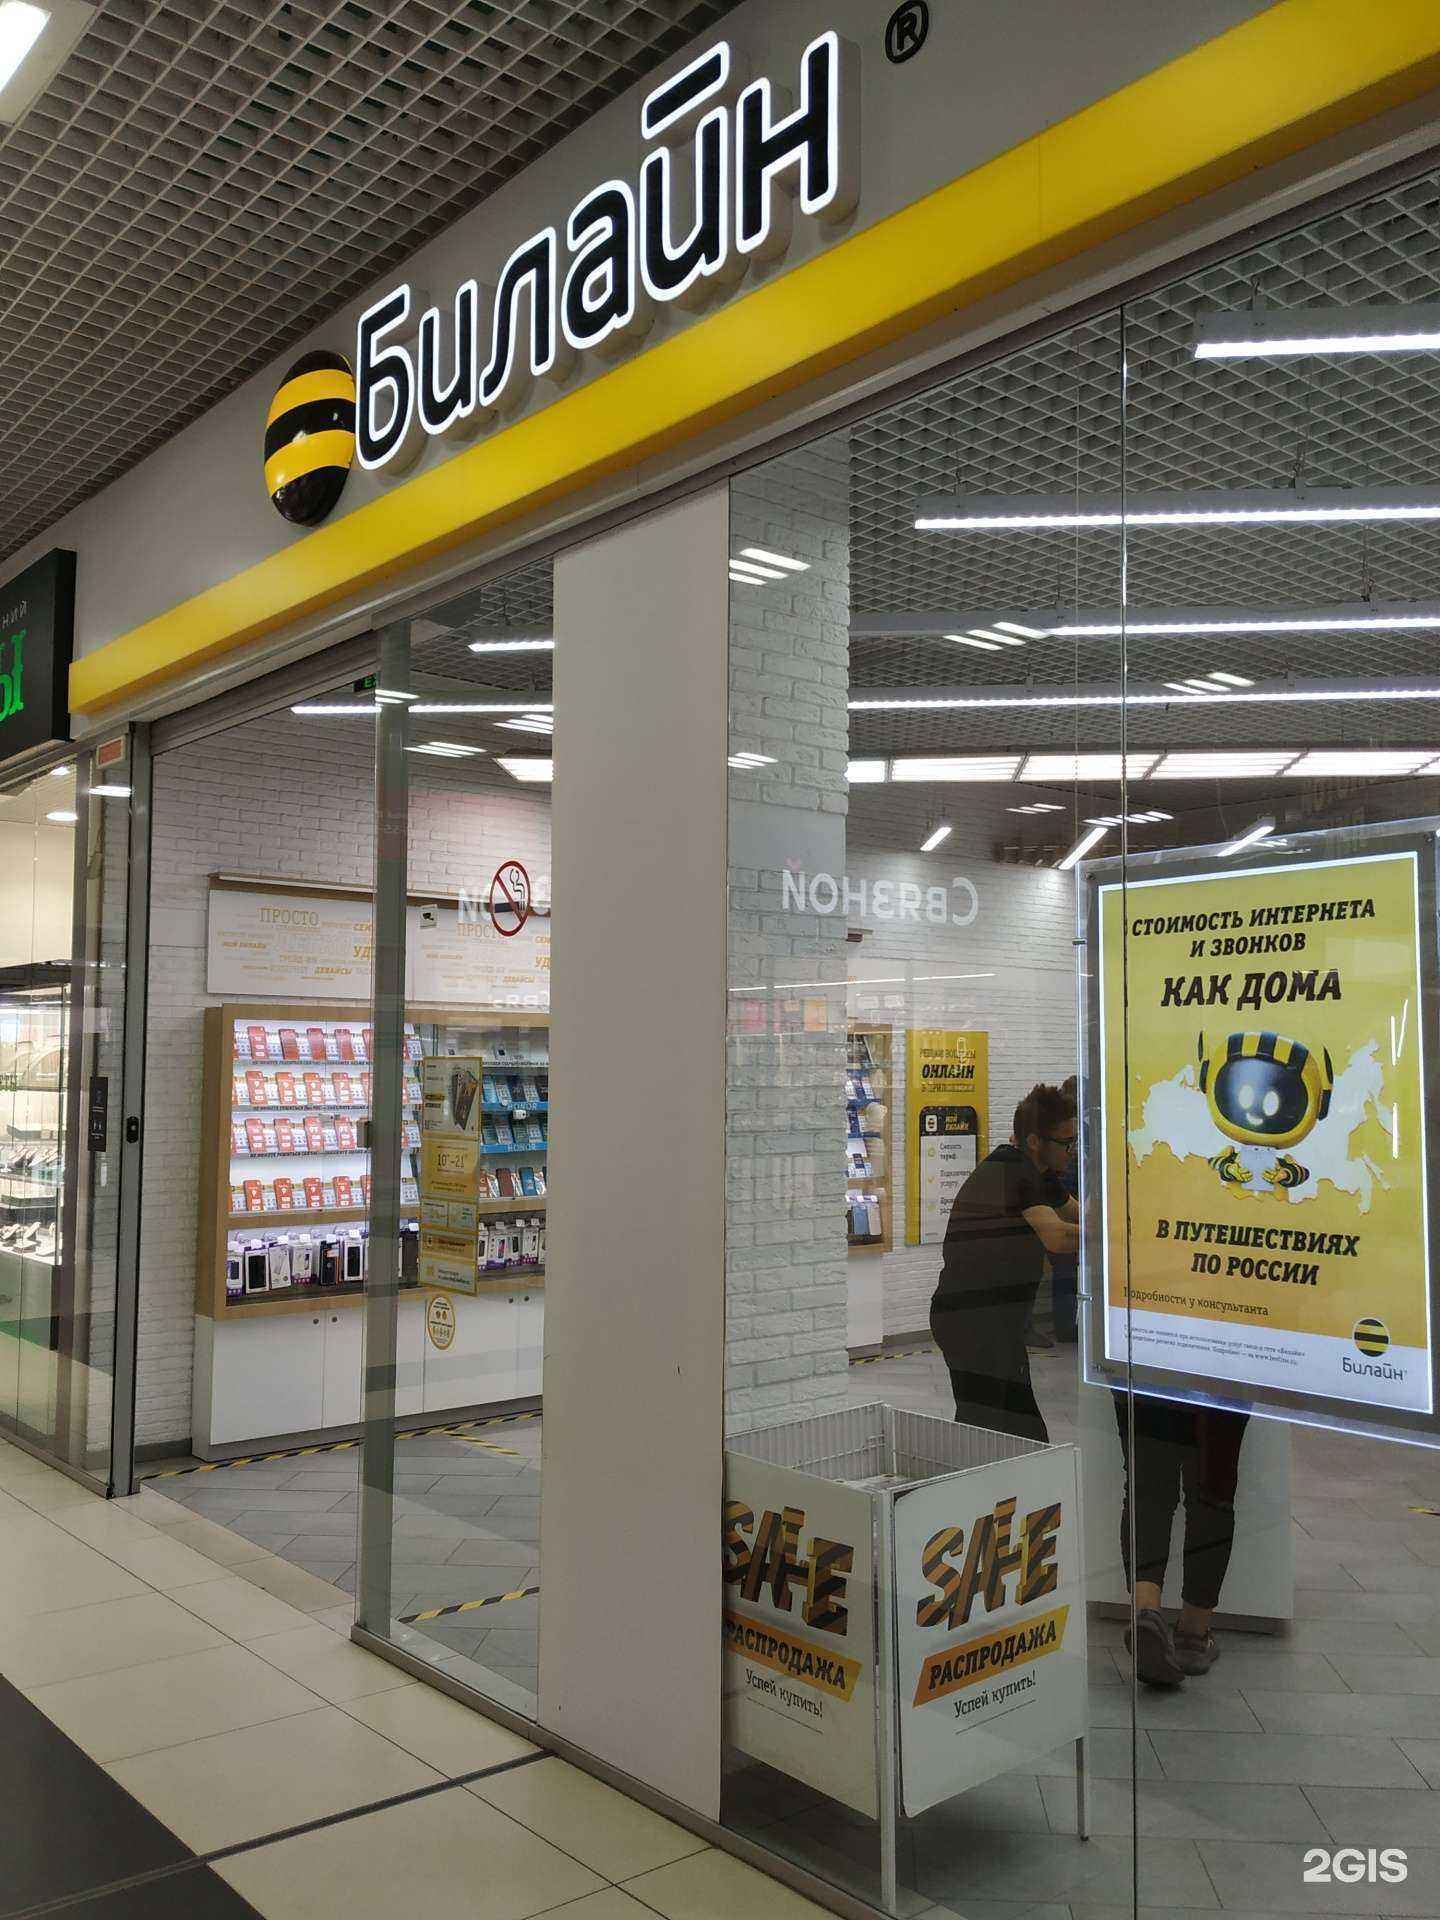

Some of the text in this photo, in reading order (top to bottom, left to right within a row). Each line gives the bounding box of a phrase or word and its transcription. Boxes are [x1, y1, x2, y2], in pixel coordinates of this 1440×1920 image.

[355, 31, 838, 470] Билайн
[259, 907, 319, 927] ПРОСТО
[1132, 899, 1375, 937] СТОИМОСТЬ ИНТЕРНЕТА
[1189, 932, 1306, 958] И ЗВОНКОВ
[1161, 968, 1342, 1011] КАК ДОМА
[1156, 1219, 1361, 1257] В ПУТЕШЕСТВИЯХ
[1191, 1253, 1320, 1286] ПО РОССИИ
[1198, 1298, 1269, 1316] консультанта
[1342, 1357, 1404, 1381] Билайн
[916, 1496, 1062, 1631] SALE
[928, 1620, 1057, 1691] РАСПРОДАЖА
[745, 1668, 822, 1718] Успей купить!
[954, 1669, 1036, 1718] Успей купить!
